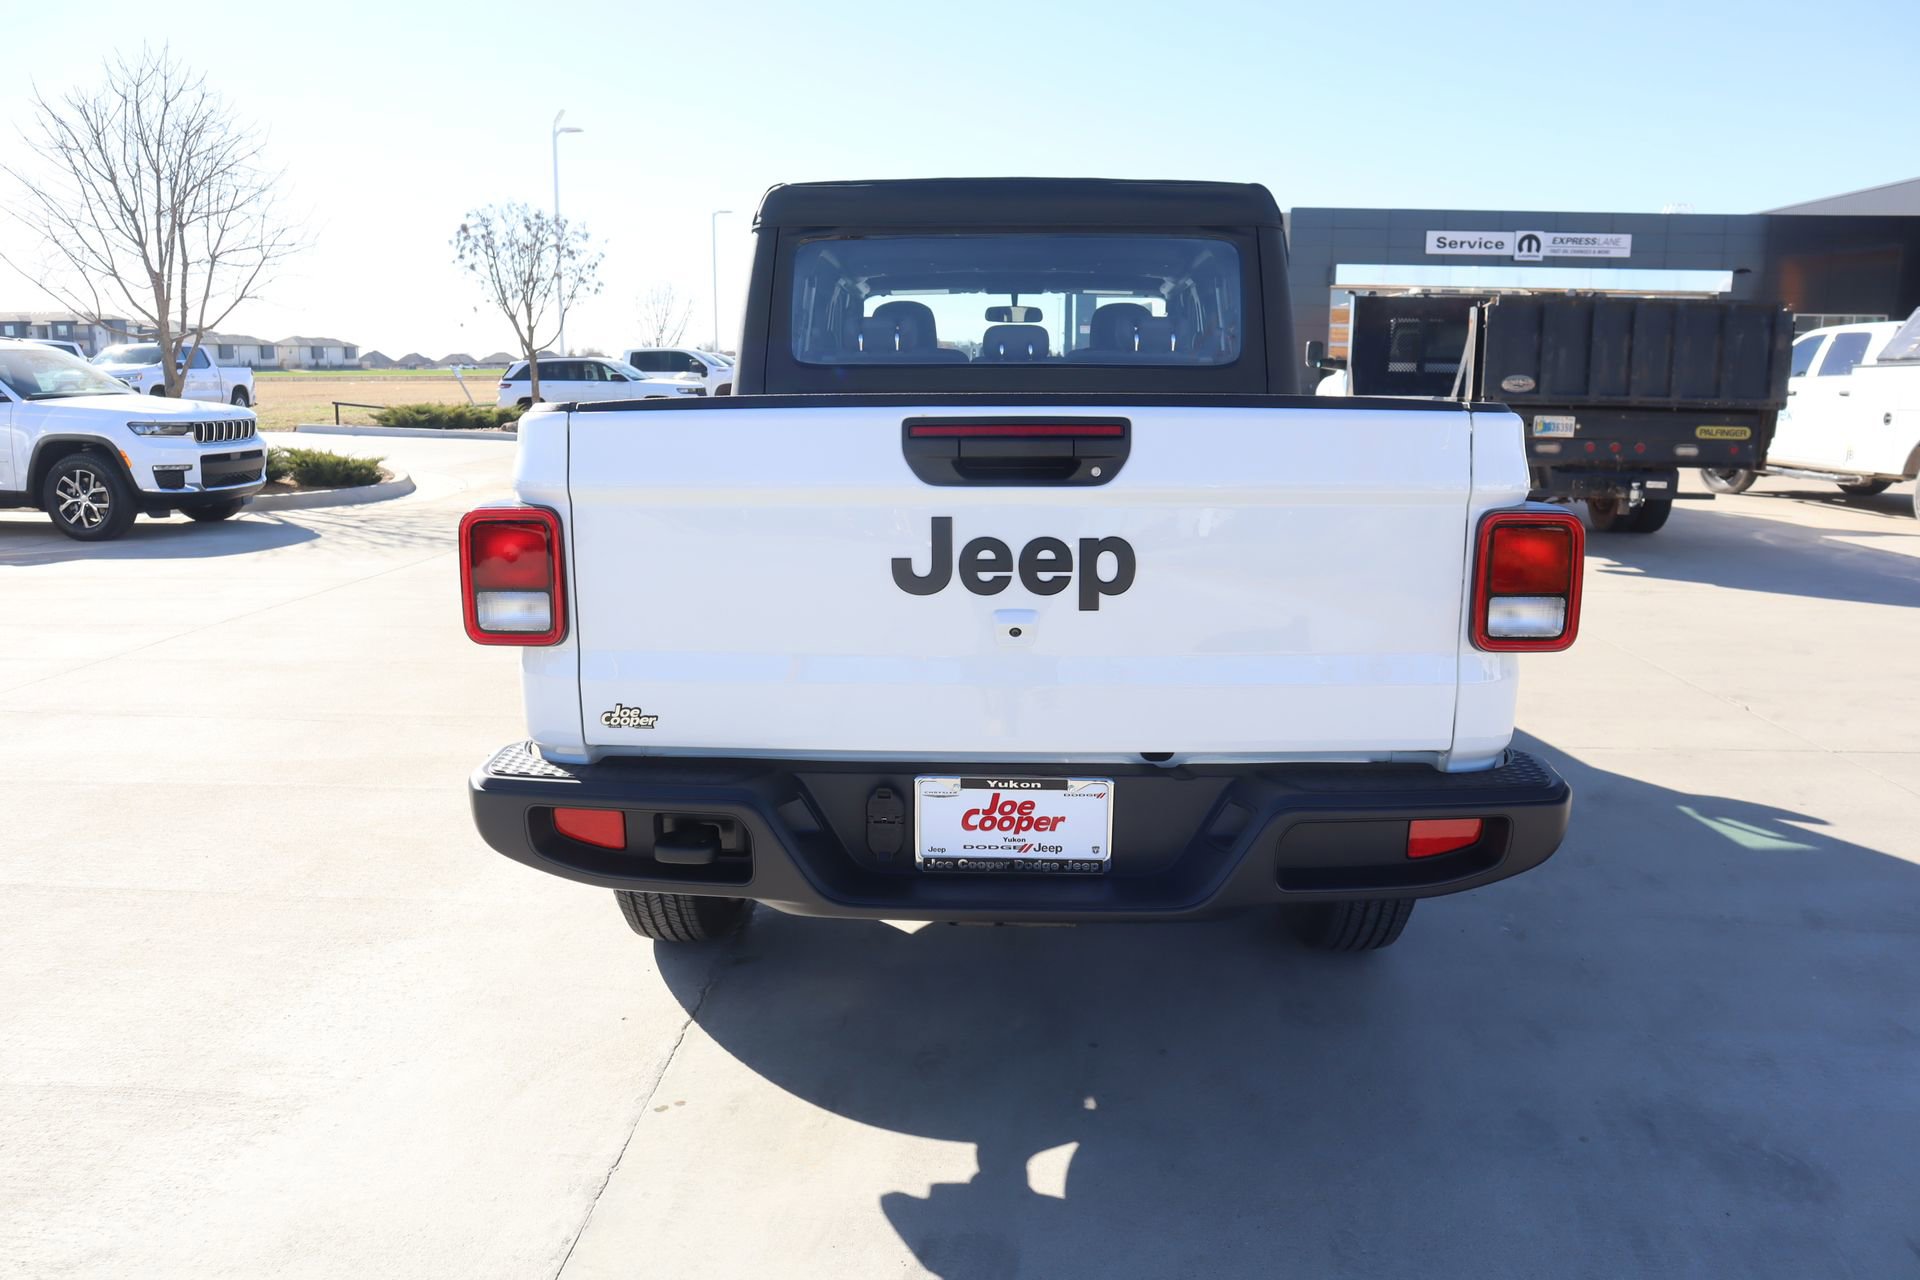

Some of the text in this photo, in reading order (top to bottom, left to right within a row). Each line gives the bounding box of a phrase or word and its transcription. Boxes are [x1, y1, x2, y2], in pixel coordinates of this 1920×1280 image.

[1436, 236, 1505, 250] Service
[1699, 428, 1748, 438] PALFINGER
[891, 516, 1136, 611] Jeep
[611, 703, 641, 718] Joe
[601, 711, 658, 728] Cooper
[986, 780, 1042, 789] Yukon
[982, 792, 1036, 816] Joe
[961, 808, 1065, 835] Cooper
[928, 846, 946, 854] Jeep
[1033, 843, 1063, 854] Jeep
[926, 858, 1099, 872] Joe Cooper Dodge Jeep
